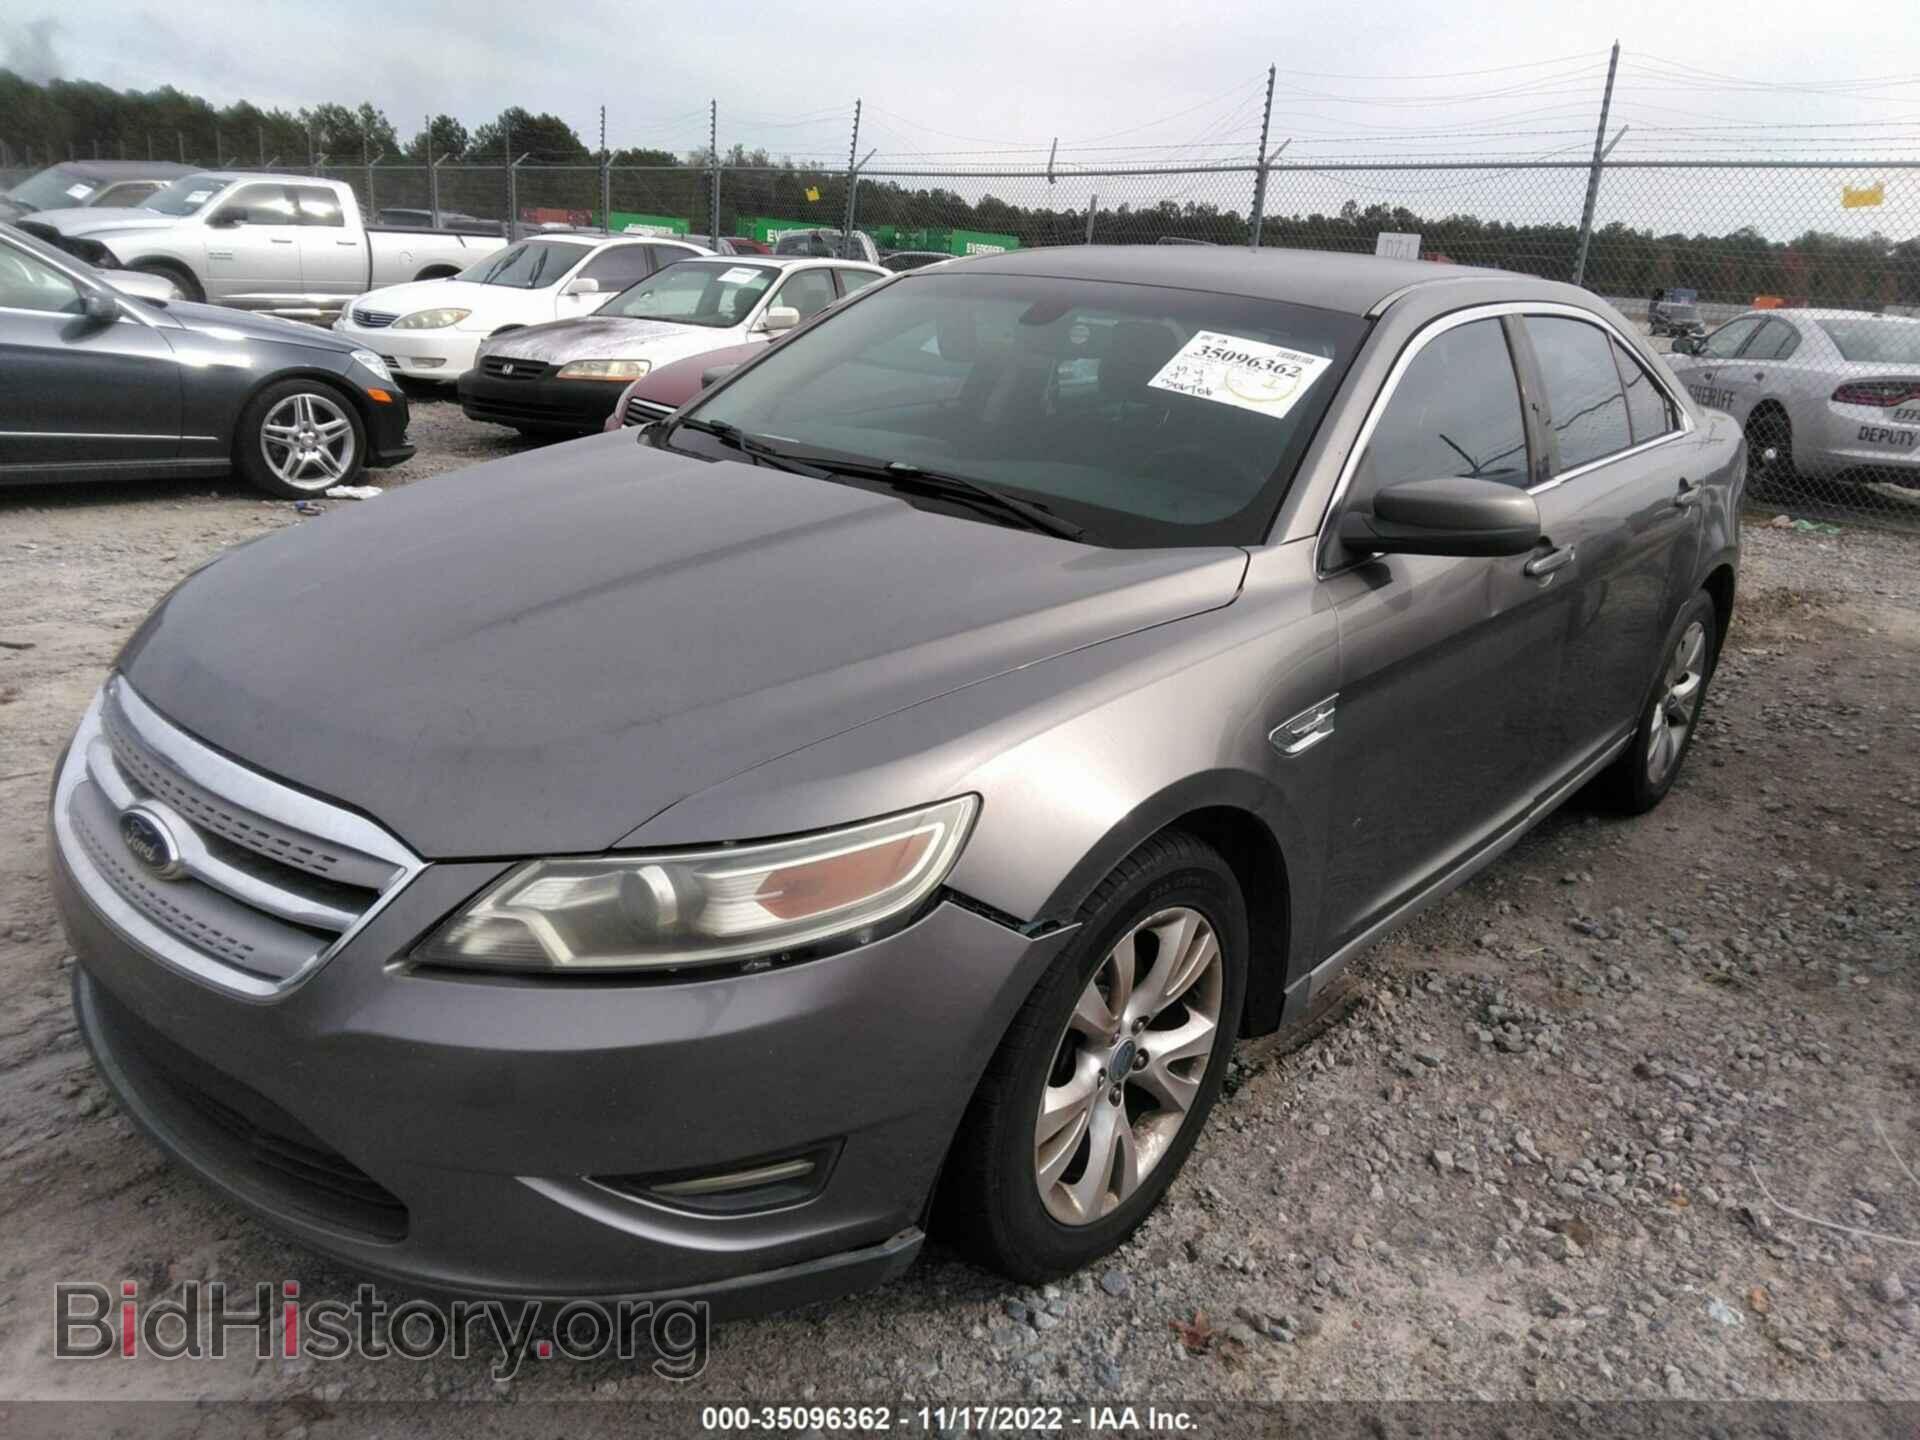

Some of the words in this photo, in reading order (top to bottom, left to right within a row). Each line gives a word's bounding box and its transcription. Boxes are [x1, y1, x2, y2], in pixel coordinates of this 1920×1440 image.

[1193, 344, 1303, 379] 35096362
[1688, 383, 1737, 410] SHERIFF
[1858, 425, 1917, 446] DEPUTY
